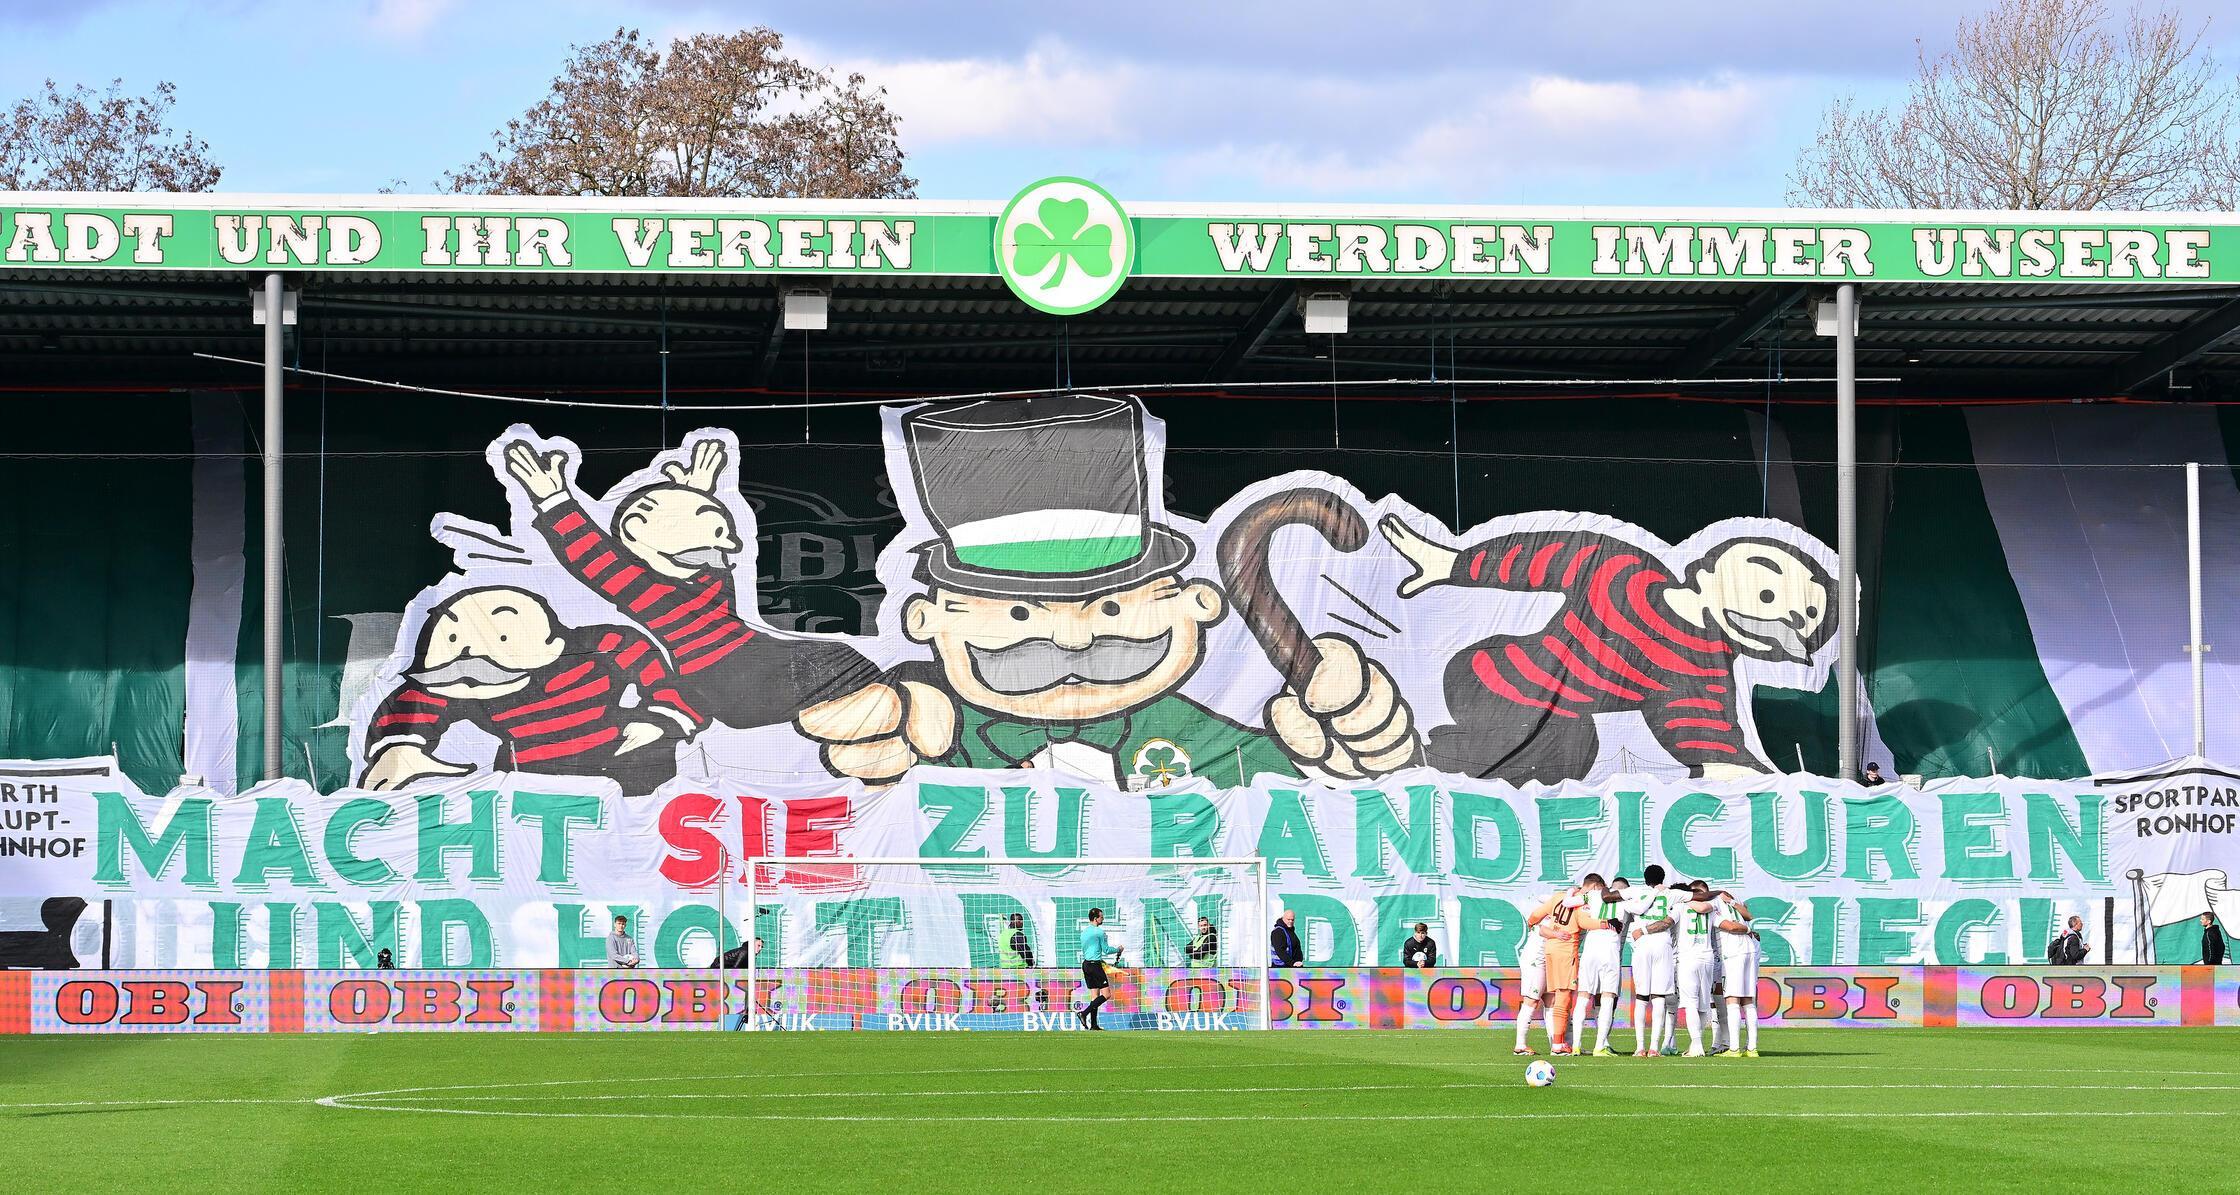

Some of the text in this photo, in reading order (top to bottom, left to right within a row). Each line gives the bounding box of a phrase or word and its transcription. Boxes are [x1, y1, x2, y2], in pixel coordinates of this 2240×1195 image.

[0, 212, 2211, 279] ADT UND IHR VEREIN WERDEN IMMER UNSERE
[0, 809, 71, 831] UPT-
[92, 784, 2113, 893] MACHT SIE ZU RANDFIGUREN
[2136, 813, 2236, 837] RONHOF
[208, 898, 498, 969] UND
[957, 893, 1228, 968] DEN
[1278, 893, 2058, 967] DERSIEG!
[1640, 895, 1667, 921] 3
